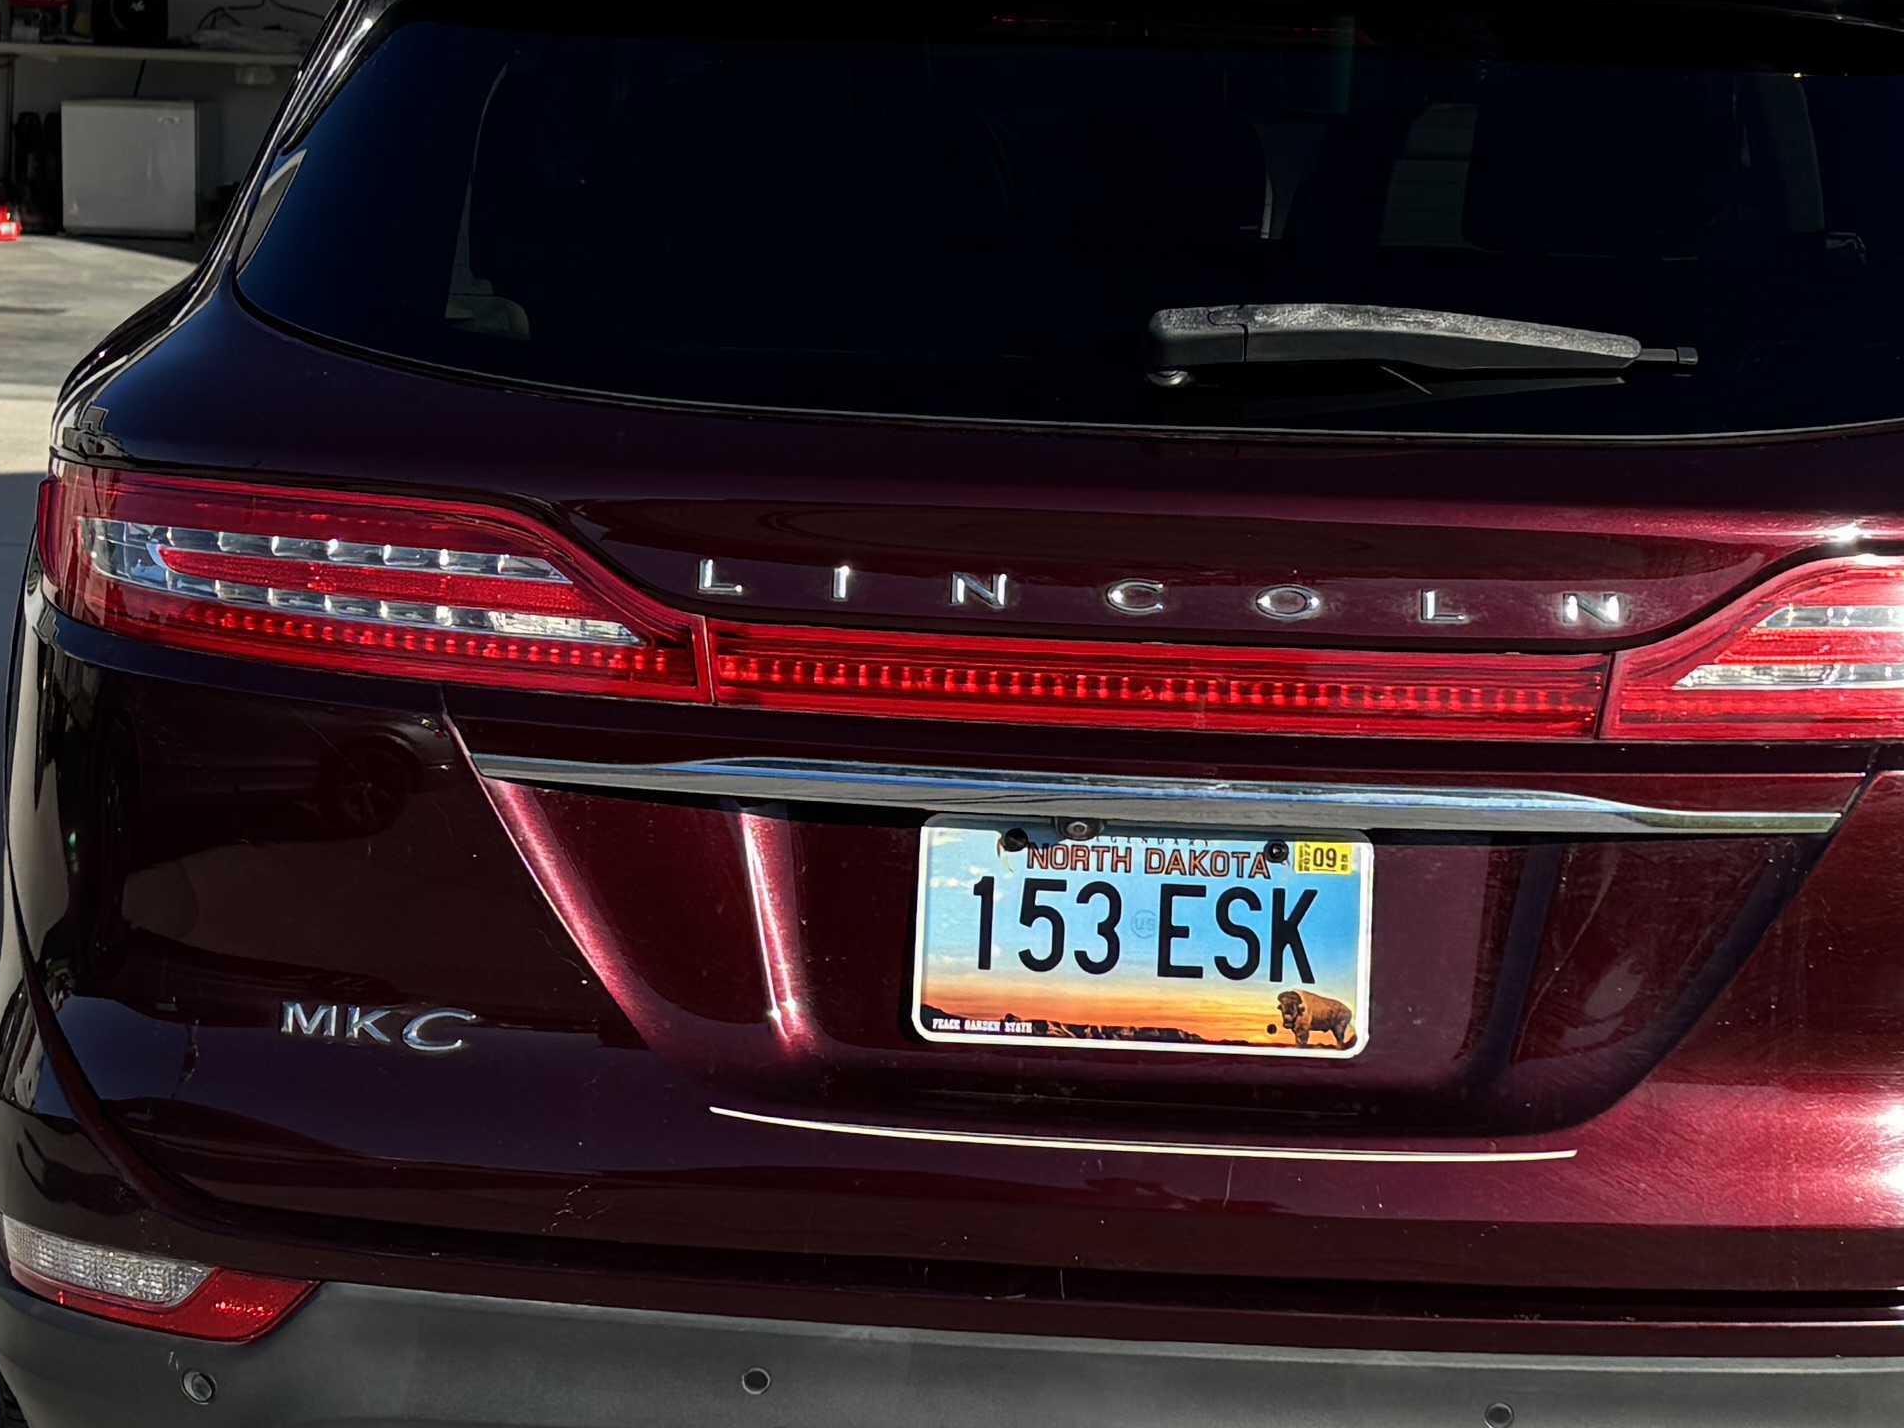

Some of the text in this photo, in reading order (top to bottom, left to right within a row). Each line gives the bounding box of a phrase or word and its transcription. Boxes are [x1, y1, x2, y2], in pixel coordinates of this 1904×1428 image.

[698, 558, 1620, 625] LINCOLN
[1026, 842, 1132, 873] NORTH
[1144, 847, 1272, 880] DAKOTA
[1313, 847, 1337, 868] 09
[973, 876, 1318, 984] 153 ESK
[280, 1002, 479, 1051] MKC
